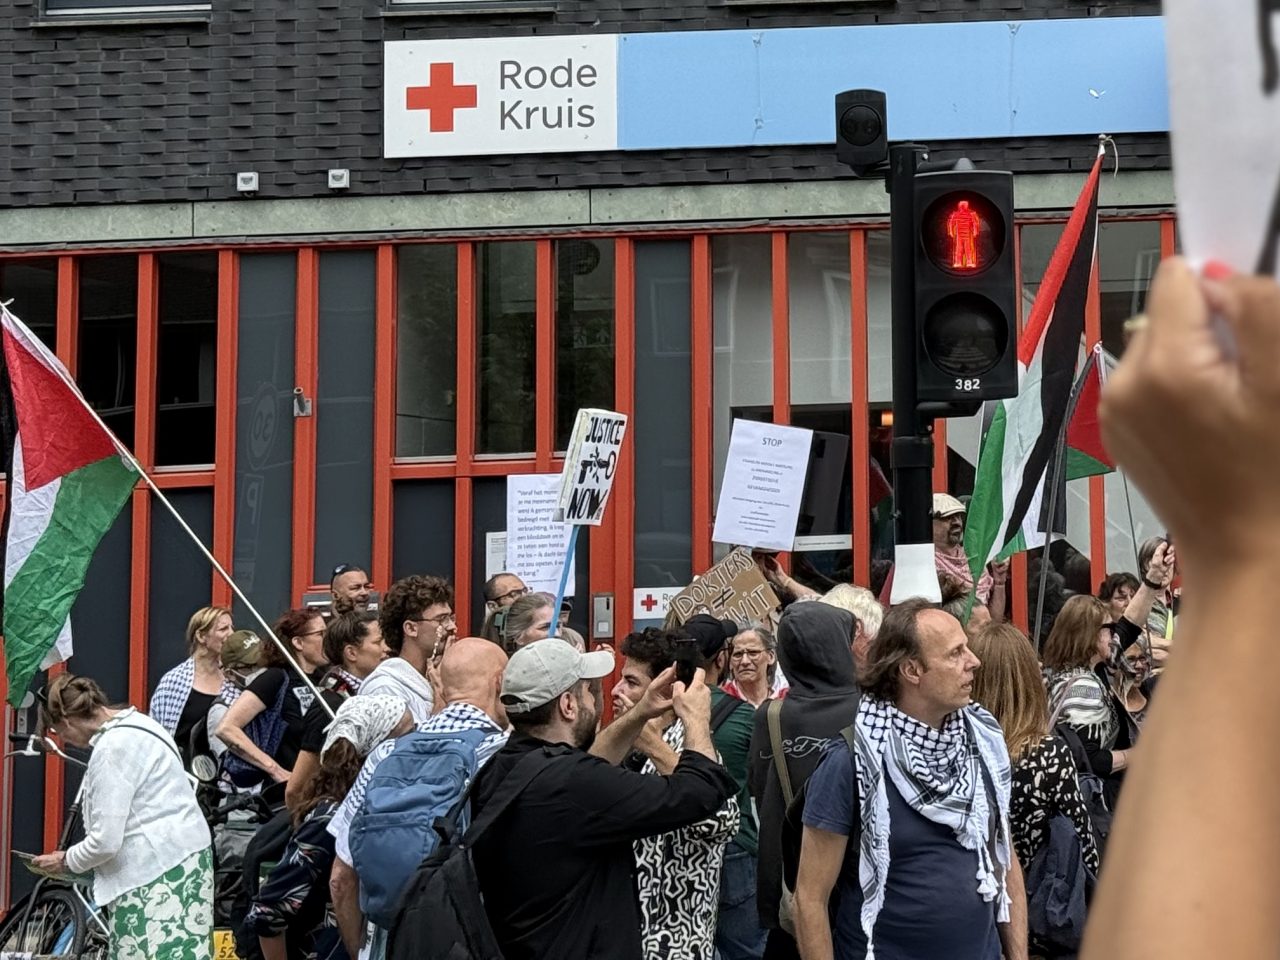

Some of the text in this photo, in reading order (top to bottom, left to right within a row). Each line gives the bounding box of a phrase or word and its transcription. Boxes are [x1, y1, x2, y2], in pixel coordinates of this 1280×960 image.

[500, 58, 597, 90] Rode
[500, 98, 595, 131] Kruis
[955, 378, 981, 391] 382
[585, 416, 625, 446] JUSTICE
[762, 436, 783, 447] STOP
[566, 487, 609, 520] NOW
[669, 547, 755, 621] DOKTERS
